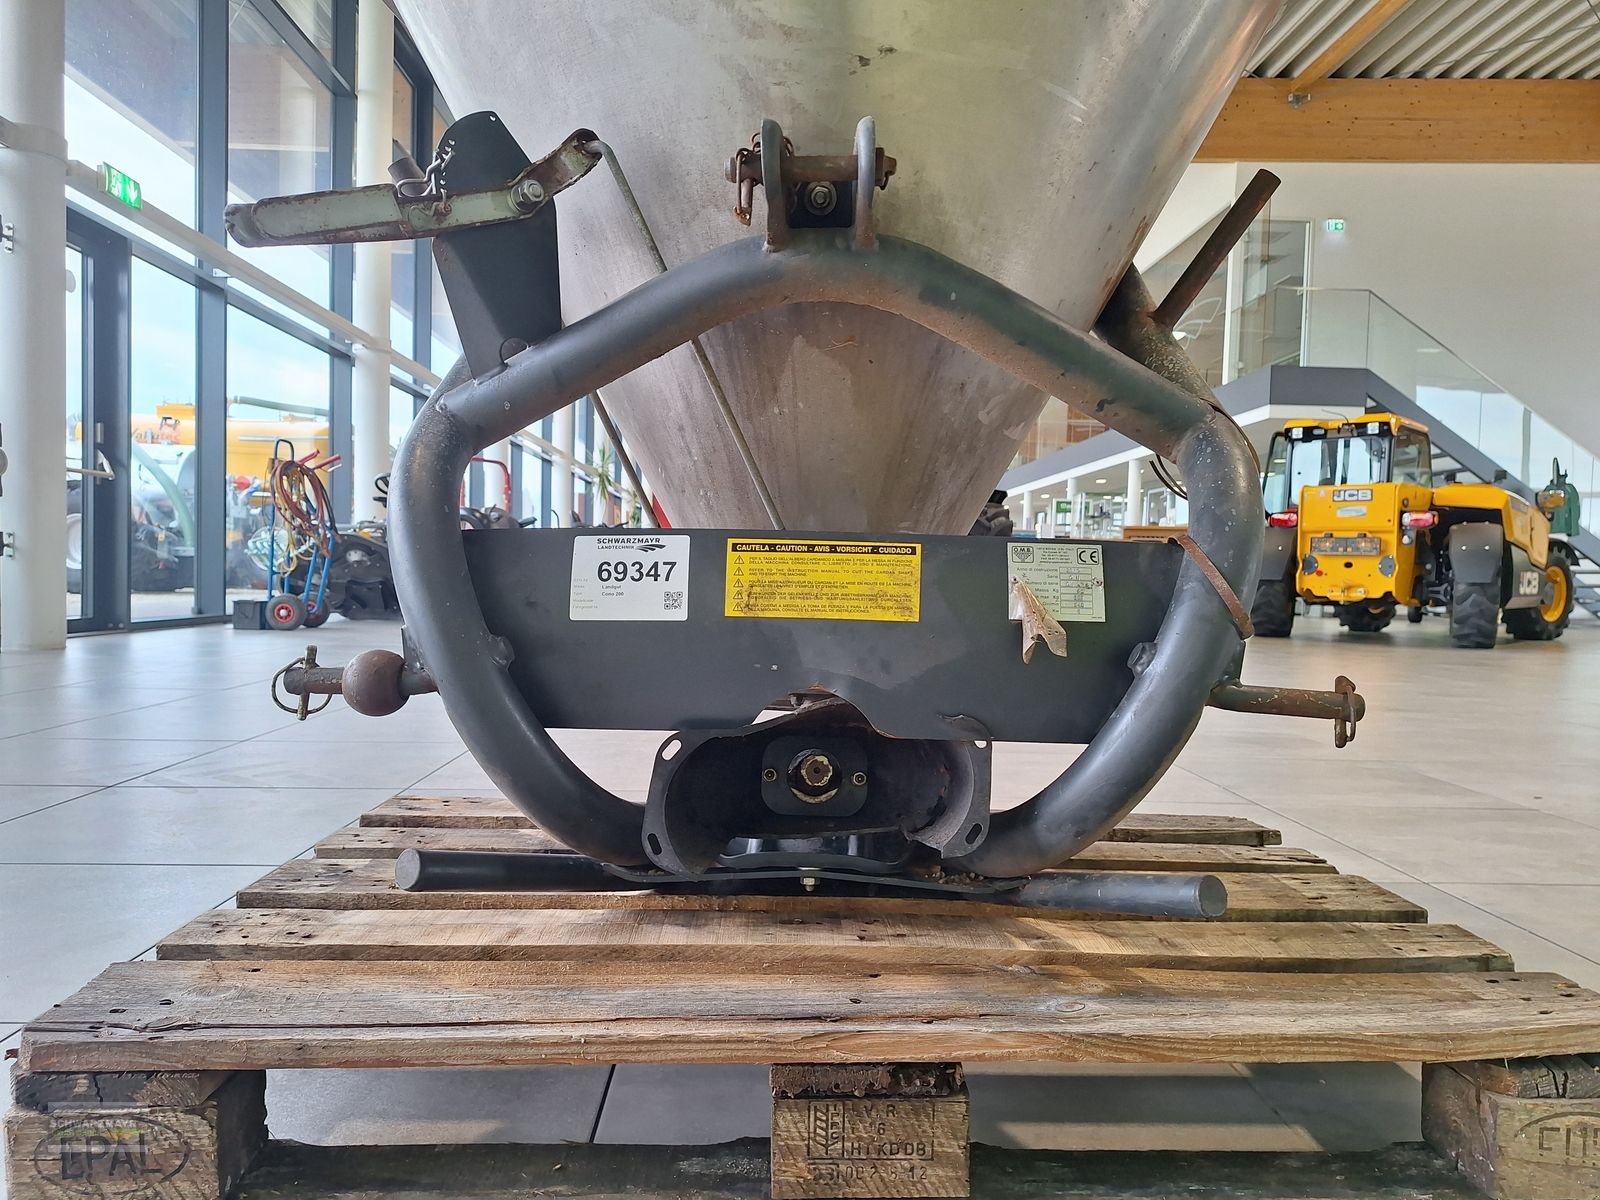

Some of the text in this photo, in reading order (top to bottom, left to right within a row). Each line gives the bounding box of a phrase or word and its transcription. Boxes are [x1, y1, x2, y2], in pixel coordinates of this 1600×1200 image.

[1333, 490, 1372, 501] JCB
[597, 561, 677, 582] 69347
[1519, 571, 1539, 595] JCB
[60, 1134, 163, 1180] EPAL
